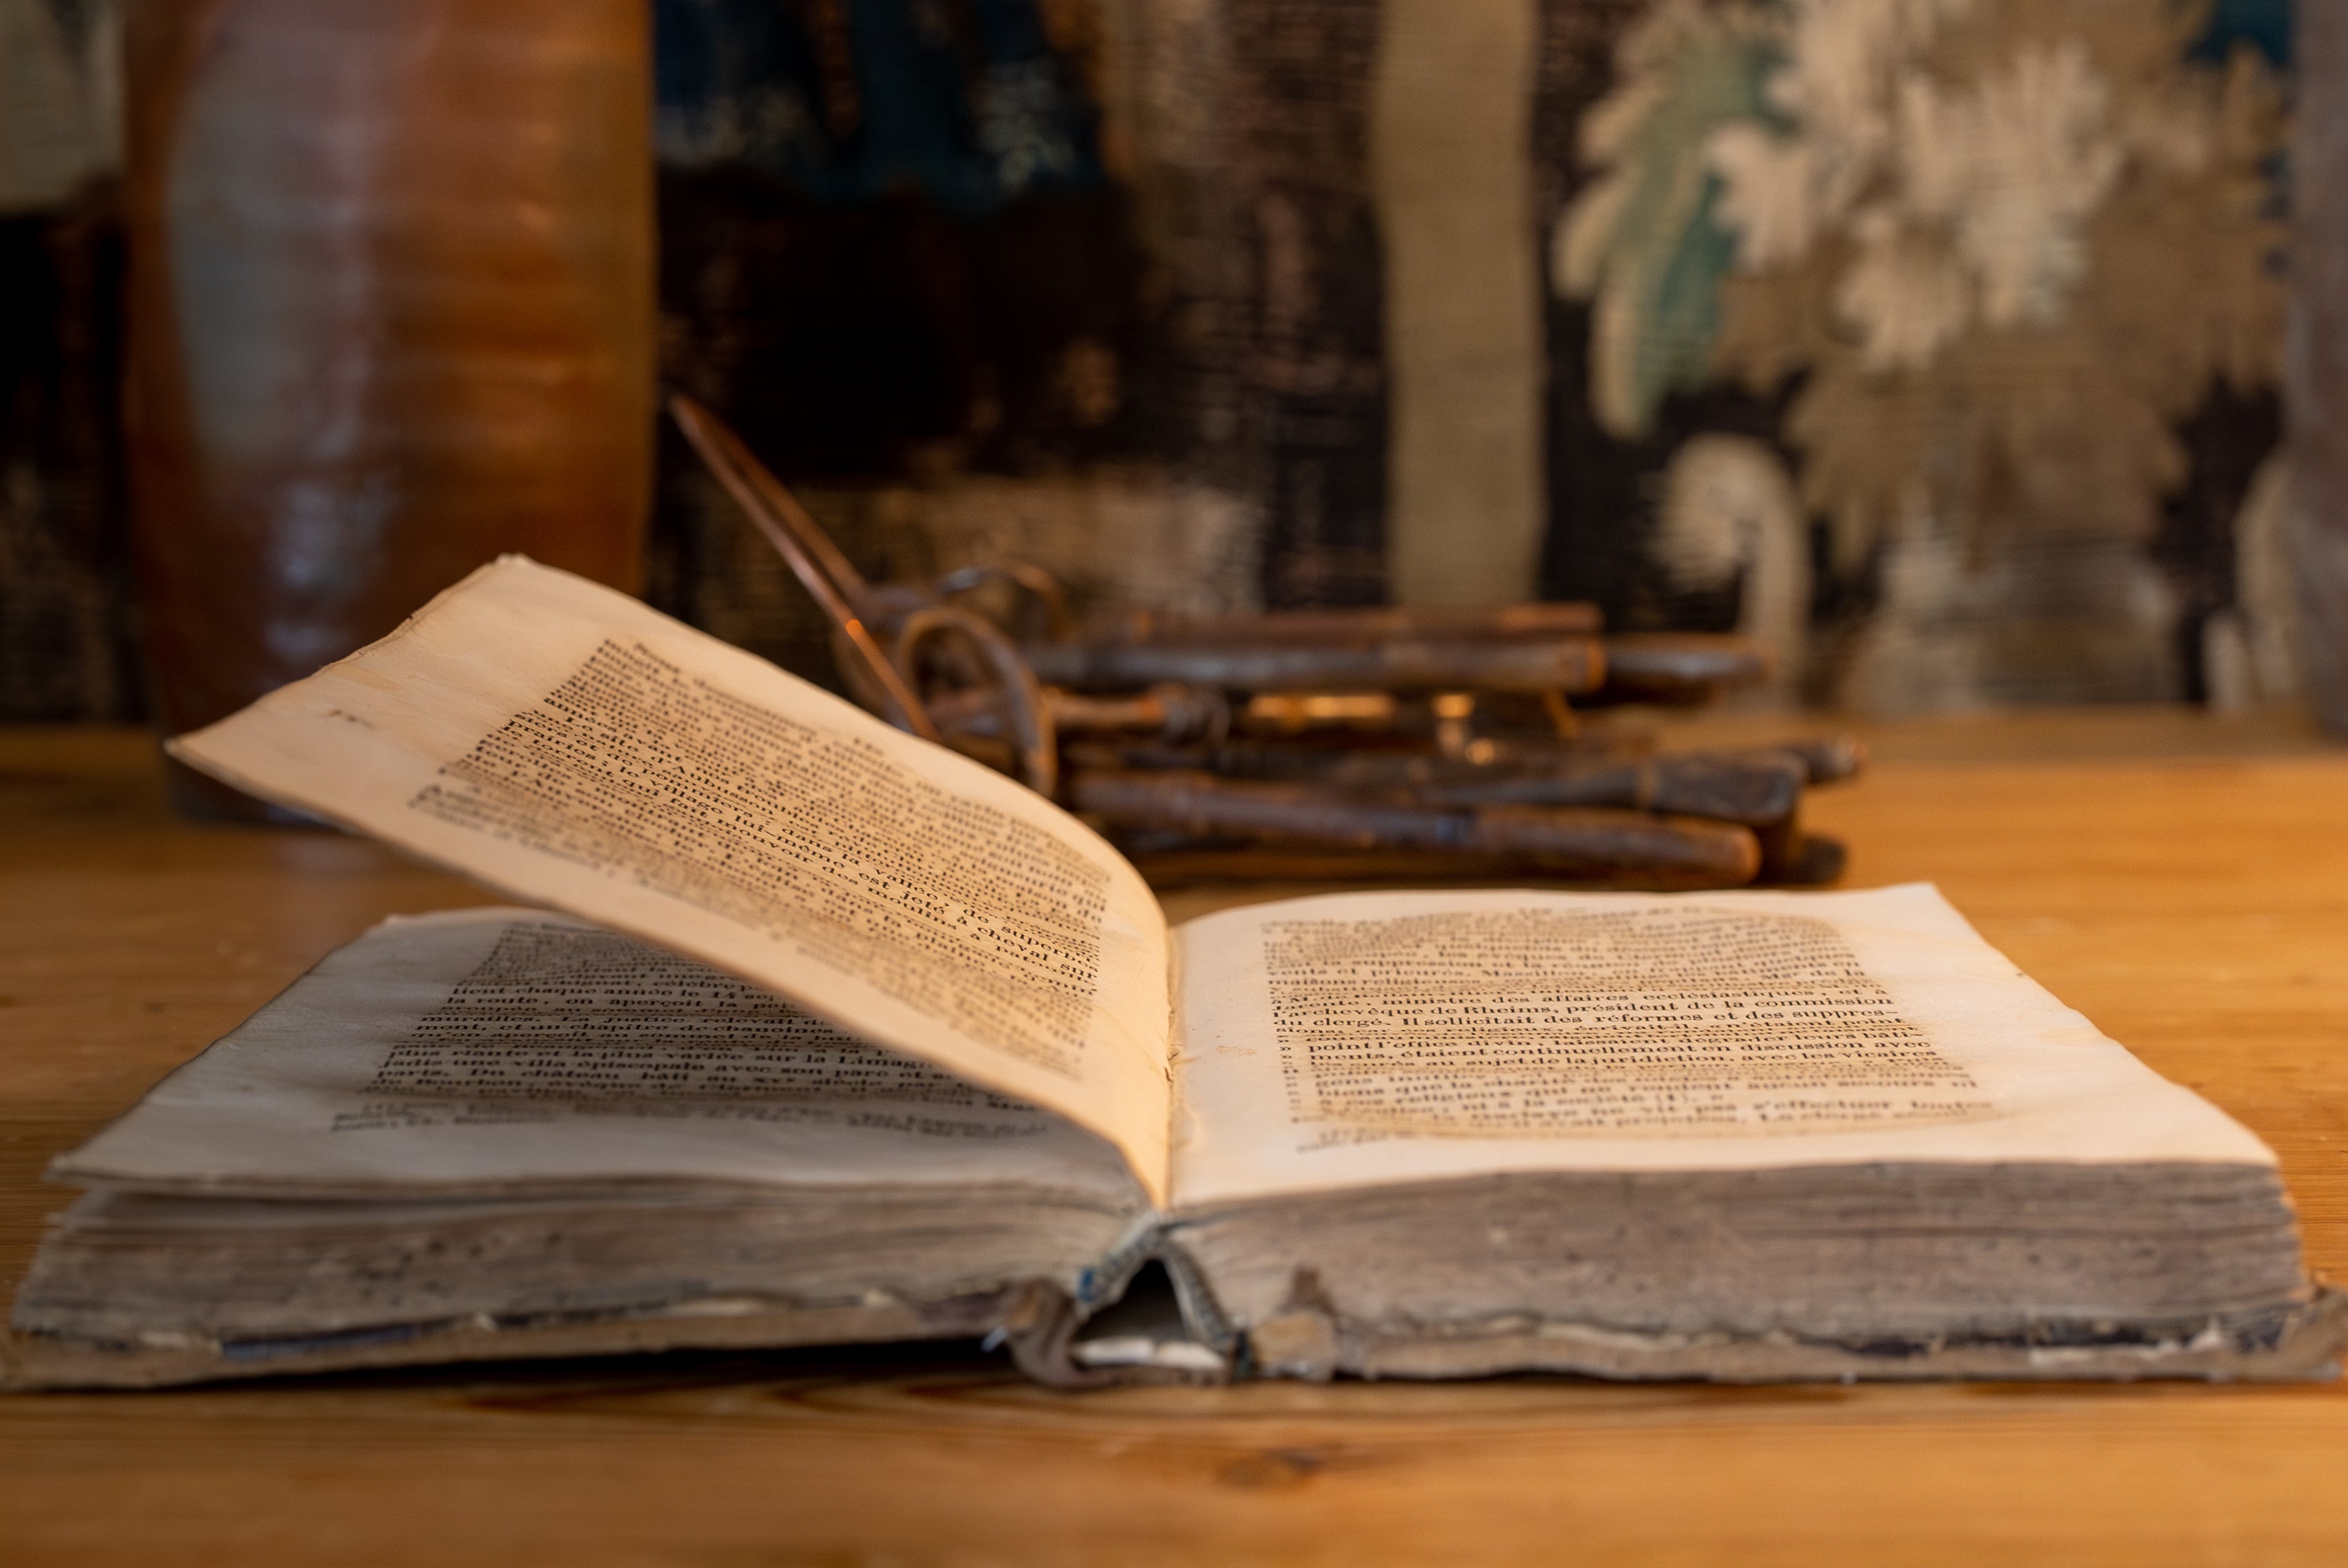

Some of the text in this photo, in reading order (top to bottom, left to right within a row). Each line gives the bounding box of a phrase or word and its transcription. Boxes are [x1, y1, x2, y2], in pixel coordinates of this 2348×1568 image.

[621, 777, 660, 799] qui
[669, 796, 708, 819] fait
[821, 864, 858, 886] des
[575, 738, 598, 752] et
[606, 751, 633, 767] de
[642, 768, 753, 819] pommiers
[780, 826, 832, 853] dans
[840, 852, 860, 866] la
[963, 907, 989, 924] de
[1000, 924, 1098, 973] superbes
[618, 764, 641, 781] le
[649, 778, 723, 817] village
[734, 814, 845, 870] lui-même
[858, 871, 890, 891] est
[898, 888, 945, 914] jeté
[956, 914, 967, 926] à
[976, 926, 1048, 962] cheval
[1059, 962, 1098, 983] sur
[609, 999, 702, 1007] aperçoit
[1541, 994, 1629, 1002] affaires
[1273, 1007, 1423, 1018] l'archevêque
[1430, 1006, 1458, 1015] de
[1463, 1006, 1559, 1015] Rheims,
[1566, 1002, 1679, 1014] président
[1723, 1000, 1746, 1009] la
[1753, 997, 1895, 1008] commission
[1312, 1018, 1392, 1028] clergé.
[1401, 1018, 1419, 1026] Il
[1423, 1016, 1536, 1026] sollicitait
[1593, 1013, 1704, 1022] réformes
[1713, 1012, 1739, 1020] et
[1744, 1011, 1784, 1020] des
[1792, 1009, 1899, 1019] suppres-
[569, 1023, 669, 1032] chapitre
[713, 1025, 833, 1033] chanoines
[1308, 1042, 1372, 1053] point
[1377, 1041, 1457, 1049] l'office
[1309, 1052, 1394, 1060] ments,
[1400, 1048, 1488, 1058] étaient
[1492, 1045, 1697, 1055] continuellement
[1739, 1042, 1866, 1051] discussion
[600, 1051, 653, 1060] plus
[805, 1054, 827, 1063] la
[1466, 1058, 1526, 1066] sujet
[1590, 1055, 1735, 1065] juridiction,
[715, 1065, 771, 1073] avec
